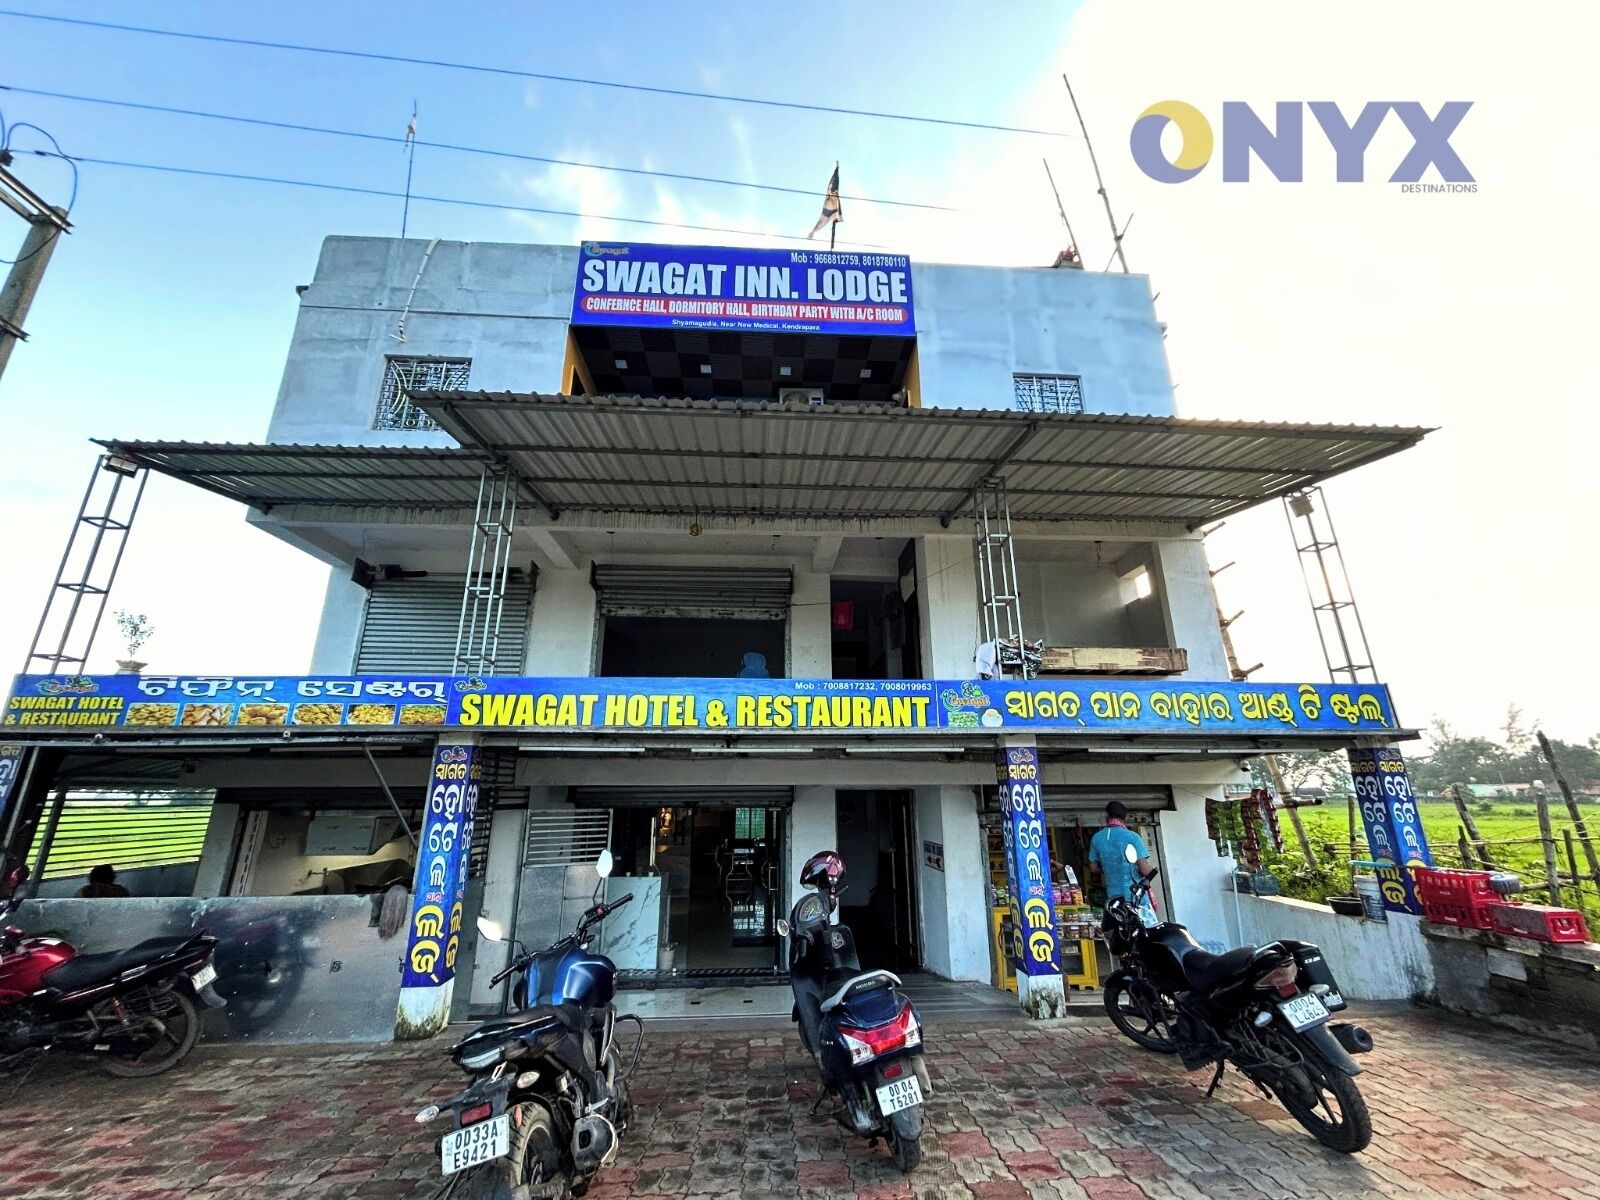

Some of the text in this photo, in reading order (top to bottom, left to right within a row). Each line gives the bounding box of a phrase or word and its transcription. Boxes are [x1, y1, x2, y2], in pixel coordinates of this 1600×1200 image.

[790, 252, 808, 263] Mob
[814, 254, 860, 266] 9668812759,
[862, 256, 906, 268] 8018780110
[582, 259, 908, 303] SWAGAT INN. LODGE
[586, 297, 903, 321] CONFERNCE HALL, DORMITORY HALL, BIRTHDAY PARTY WITH A/C ROOM
[782, 323, 820, 331] Kendrapara
[823, 682, 878, 691] 7008817232,
[880, 682, 932, 690] 7008019963
[10, 696, 124, 710] SWAGAT HOTEL
[460, 694, 930, 727] SWAGAT HOTEL & RESTAURANT
[1090, 690, 1141, 718] ପାନ
[1150, 692, 1234, 726] ବାହାର
[1298, 683, 1322, 719] ଟି
[4, 712, 120, 726] & RESTAURANT
[454, 1120, 498, 1150] OD33A
[454, 1140, 496, 1170] E9421
